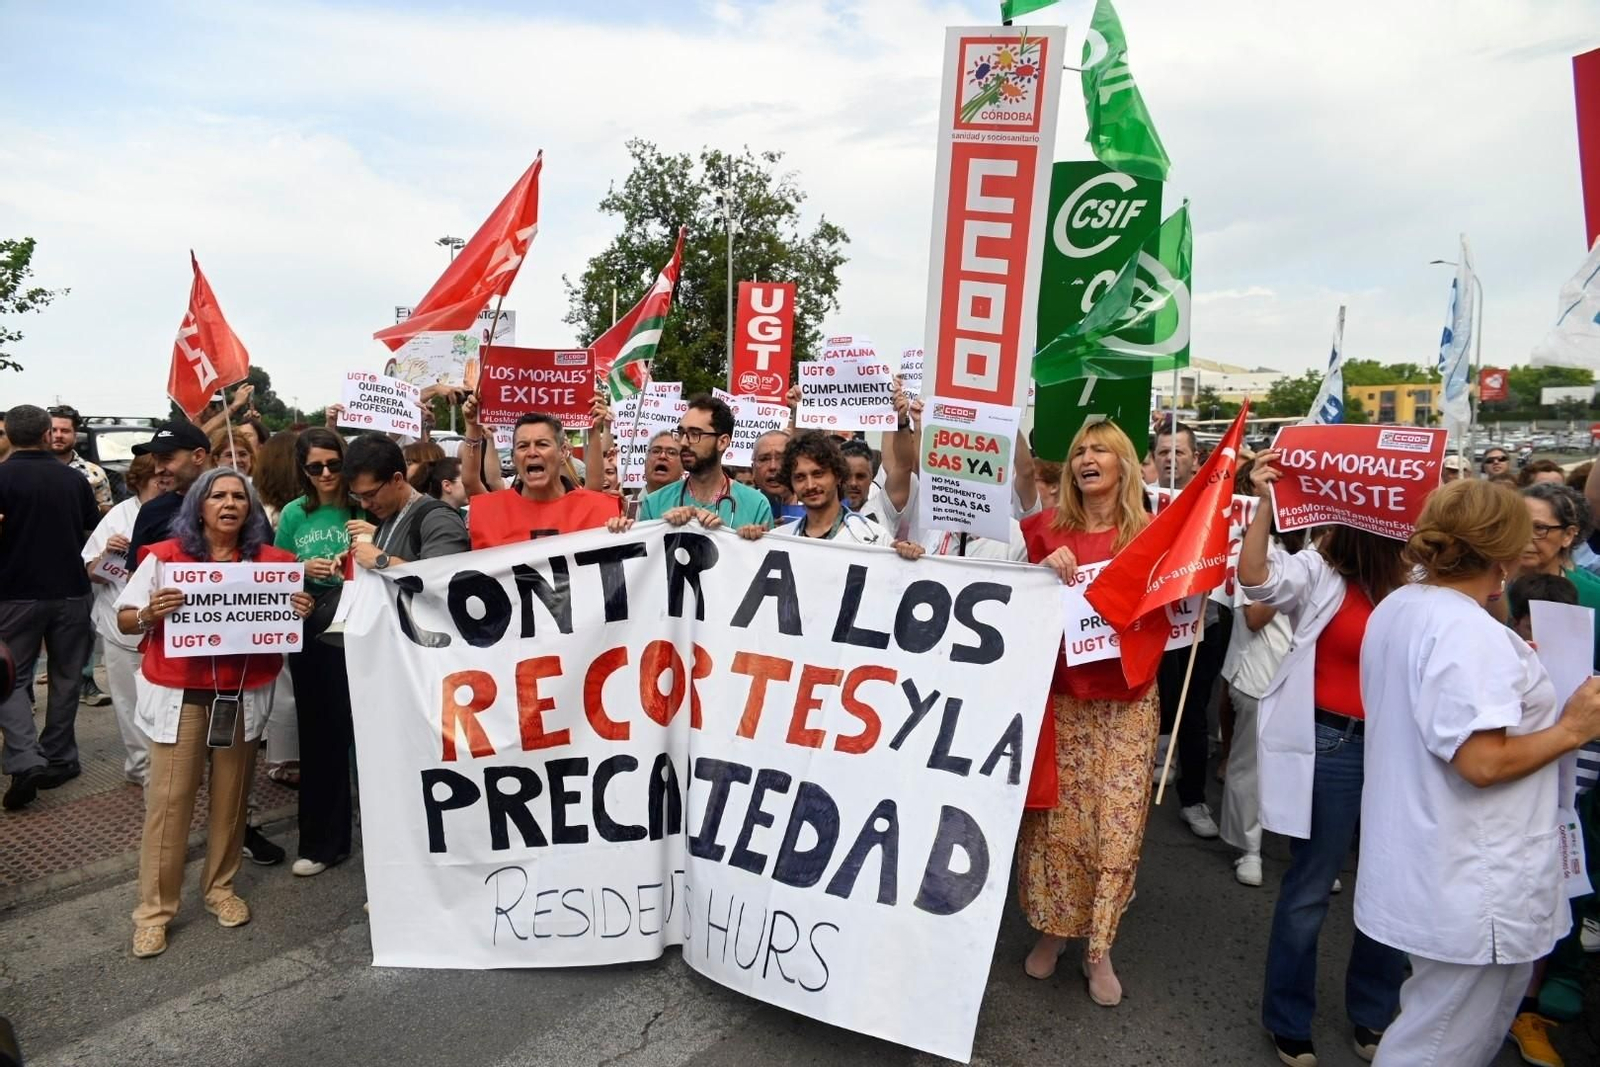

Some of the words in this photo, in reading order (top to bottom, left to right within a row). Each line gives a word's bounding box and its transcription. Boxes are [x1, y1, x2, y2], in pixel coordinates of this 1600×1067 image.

[981, 108, 1033, 122] CÓRDOBA
[952, 132, 980, 142] sanidad
[981, 134, 986, 144] y
[987, 133, 1040, 143] sociosanitario
[1071, 198, 1148, 230] CSIF
[951, 157, 1018, 393] CCOO
[747, 287, 784, 370] UGT
[903, 350, 916, 358] UGT
[347, 372, 367, 381] UGT
[803, 366, 824, 376] UGT
[857, 365, 880, 376] UGT
[358, 381, 394, 395] QUIERO
[396, 389, 407, 399] MI
[394, 381, 411, 392] UGT
[359, 393, 404, 409] CARRERA
[500, 385, 576, 405] EXISTE
[802, 398, 815, 407] DE
[818, 397, 838, 407] LOS
[840, 396, 895, 406] ACUERDOS
[349, 400, 413, 419] PROFESIONAL
[643, 398, 653, 407] GT
[674, 403, 687, 411] UG
[342, 411, 363, 423] UGT
[757, 406, 778, 416] UGT
[945, 408, 969, 416] CCOO
[391, 420, 411, 430] UGT
[802, 414, 825, 423] UGT
[860, 415, 883, 425] UGT
[933, 430, 1000, 454] ¡BOLSA
[1394, 434, 1421, 443] CCOO
[633, 457, 645, 465] LO
[927, 452, 962, 472] SAS
[966, 458, 993, 477] YA
[944, 478, 960, 487] MAS
[932, 485, 987, 501] IMPEDIMENTOS
[1298, 475, 1406, 511] EXISTE
[932, 494, 968, 508] BOLSA
[970, 501, 991, 513] SAS
[294, 529, 334, 548] ESCUELA
[102, 562, 128, 578] UGT
[173, 570, 206, 583] UGT
[254, 571, 286, 583] UGT
[184, 592, 295, 606] UMPLIMIENT
[395, 532, 803, 648] CONTRA
[831, 563, 1013, 665] LOS
[172, 612, 190, 624] DE
[194, 611, 222, 623] LOS
[226, 610, 300, 622] ACUERDOS
[1170, 623, 1190, 639] GT
[172, 635, 205, 648] UGT
[252, 633, 283, 645] UGT
[1072, 636, 1105, 655] UGT
[441, 639, 898, 762] RECORTES
[889, 678, 941, 751] Y
[926, 697, 1024, 786] LA
[420, 752, 990, 916] PRECAIEDAD
[706, 888, 840, 992] HURS
